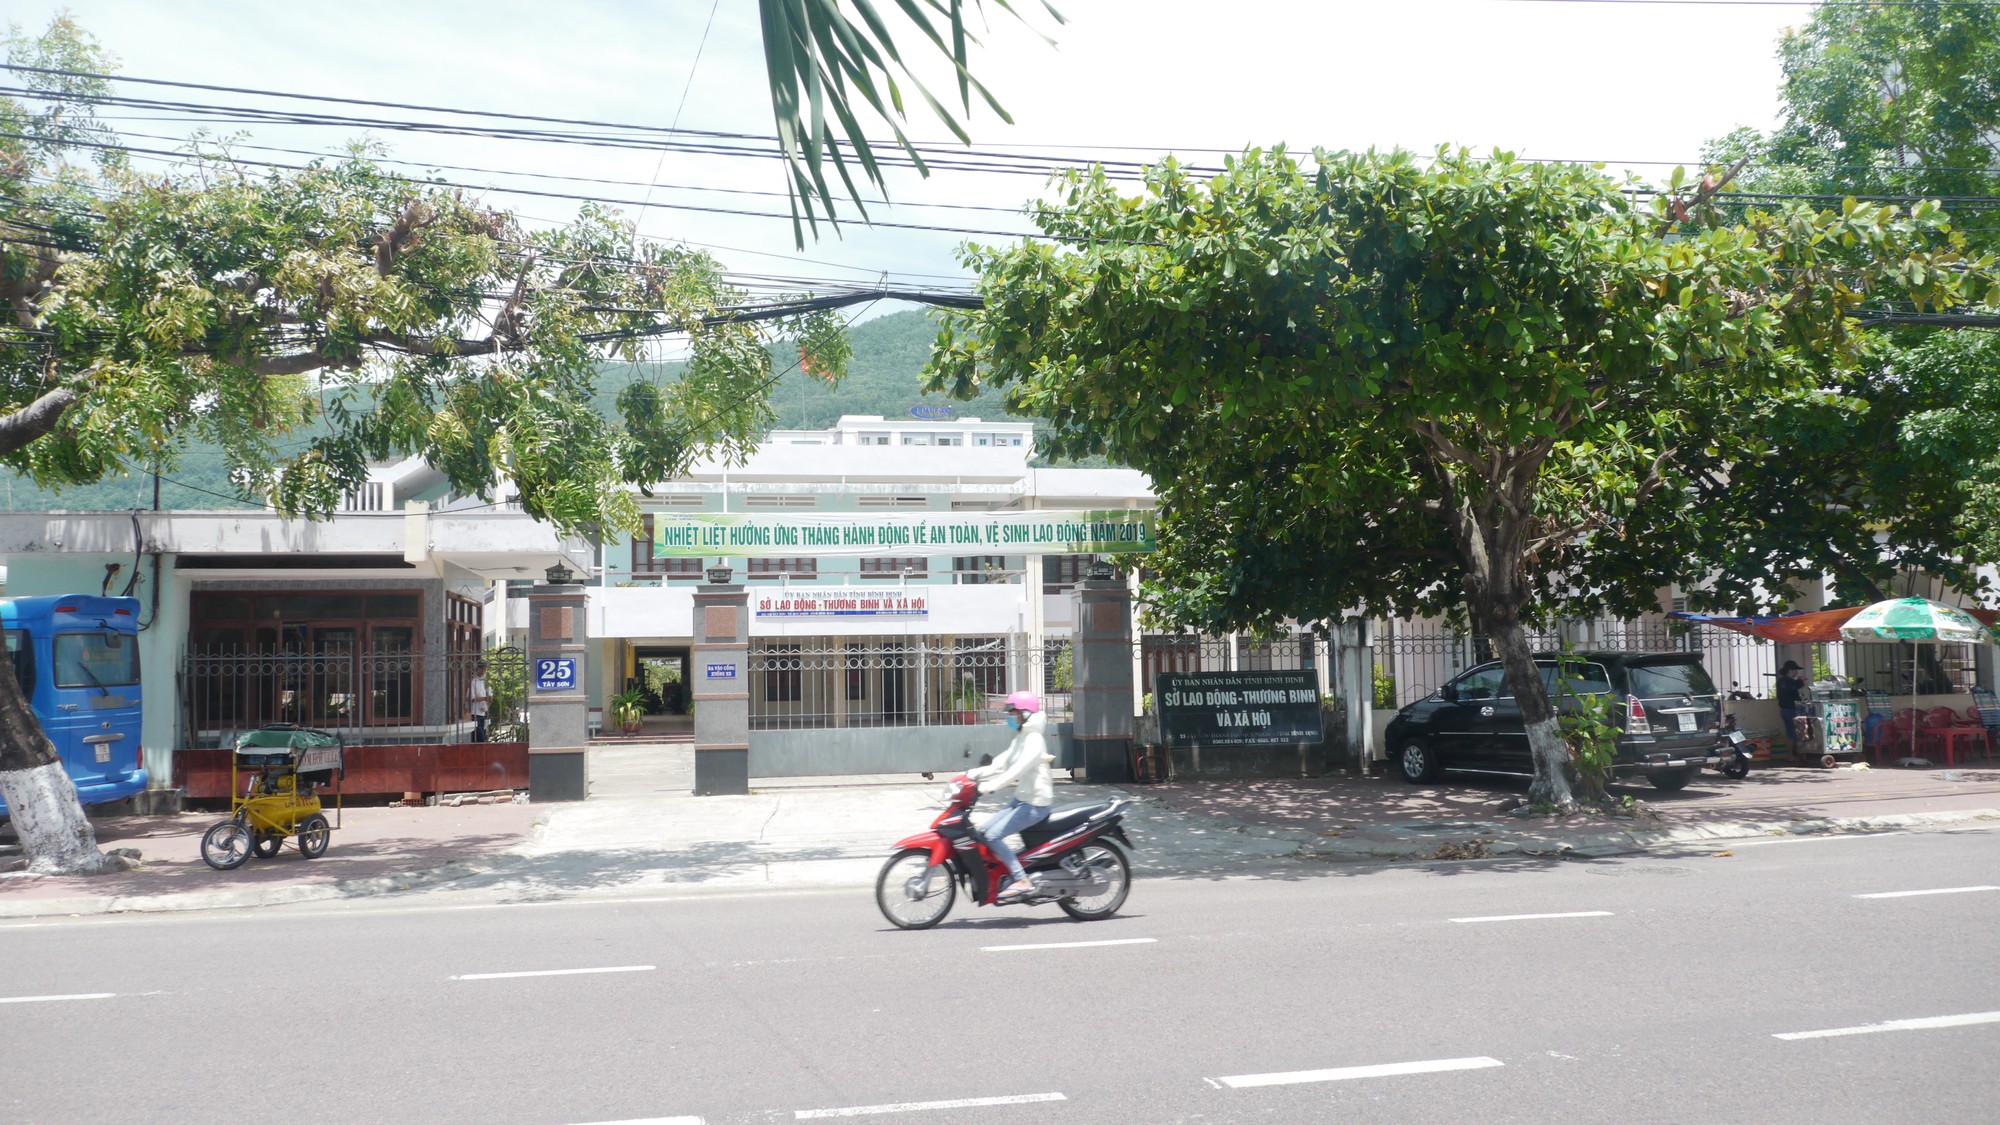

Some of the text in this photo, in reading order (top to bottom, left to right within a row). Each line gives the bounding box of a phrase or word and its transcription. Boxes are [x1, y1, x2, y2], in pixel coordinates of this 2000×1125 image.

[665, 520, 1146, 550] NHIỆT LIỆT HƯỞNG ỨNG THÁNG HÀNH ĐỘNG VỀ AN TOÀN, VỆ SINH LAO ĐỘNG NĂM 2019
[760, 597, 771, 610] SỞ
[775, 600, 790, 610] LAO
[794, 598, 816, 610] ĐỘNG
[823, 599, 856, 609] THƯƠNG
[860, 599, 879, 609] BINH
[883, 597, 893, 609] VÀ
[897, 597, 908, 608] XÃ
[911, 597, 924, 610] HỘI
[541, 661, 571, 679] 25
[1172, 677, 1182, 686] ỦY
[1202, 677, 1224, 686] NHÂN
[1226, 677, 1241, 685] DÂN
[1244, 676, 1262, 684] TỈNH
[1264, 675, 1283, 684] BÌNH
[1165, 688, 1180, 706] SỞ
[1183, 692, 1203, 706] LAO
[1289, 690, 1316, 703] BINH
[1217, 709, 1271, 729] VÀ XÃ HỘI
